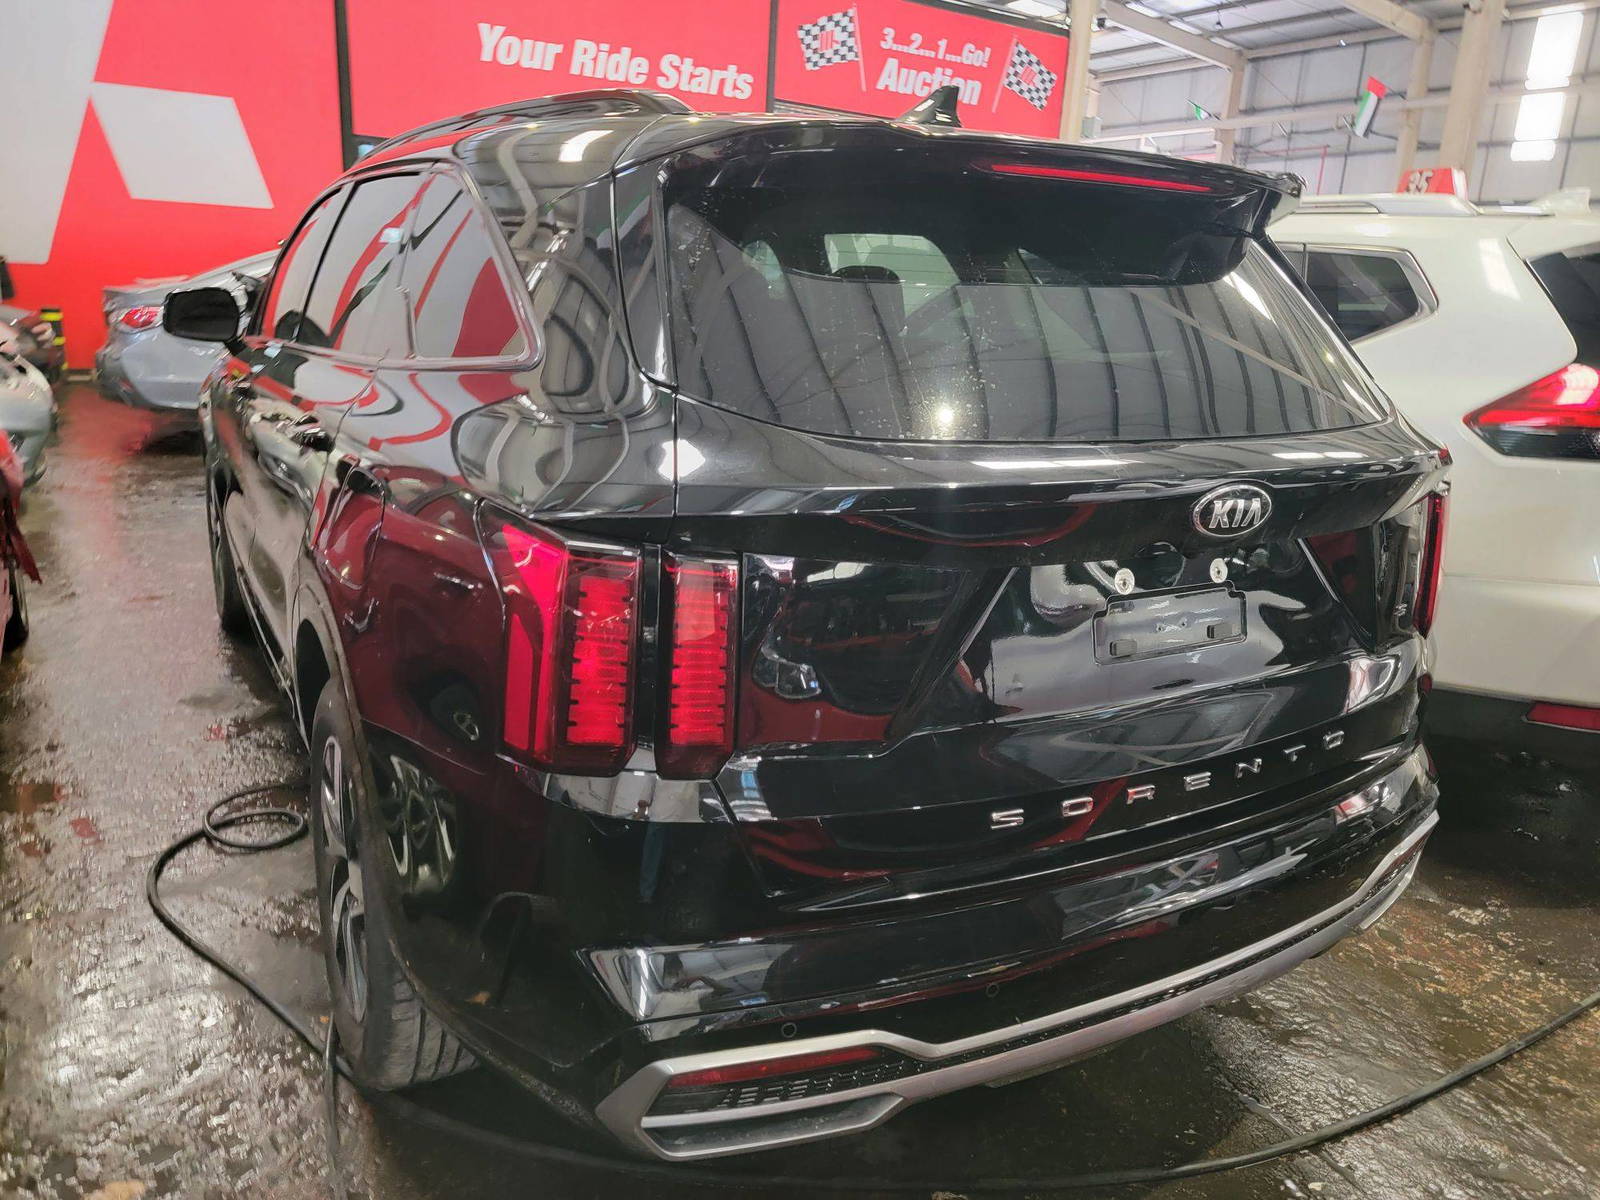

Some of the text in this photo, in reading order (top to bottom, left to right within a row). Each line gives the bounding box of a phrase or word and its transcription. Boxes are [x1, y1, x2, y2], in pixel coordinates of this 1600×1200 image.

[477, 22, 754, 100] Your Ride Starts
[1208, 497, 1262, 529] KIA
[990, 729, 1346, 831] SORENTO
